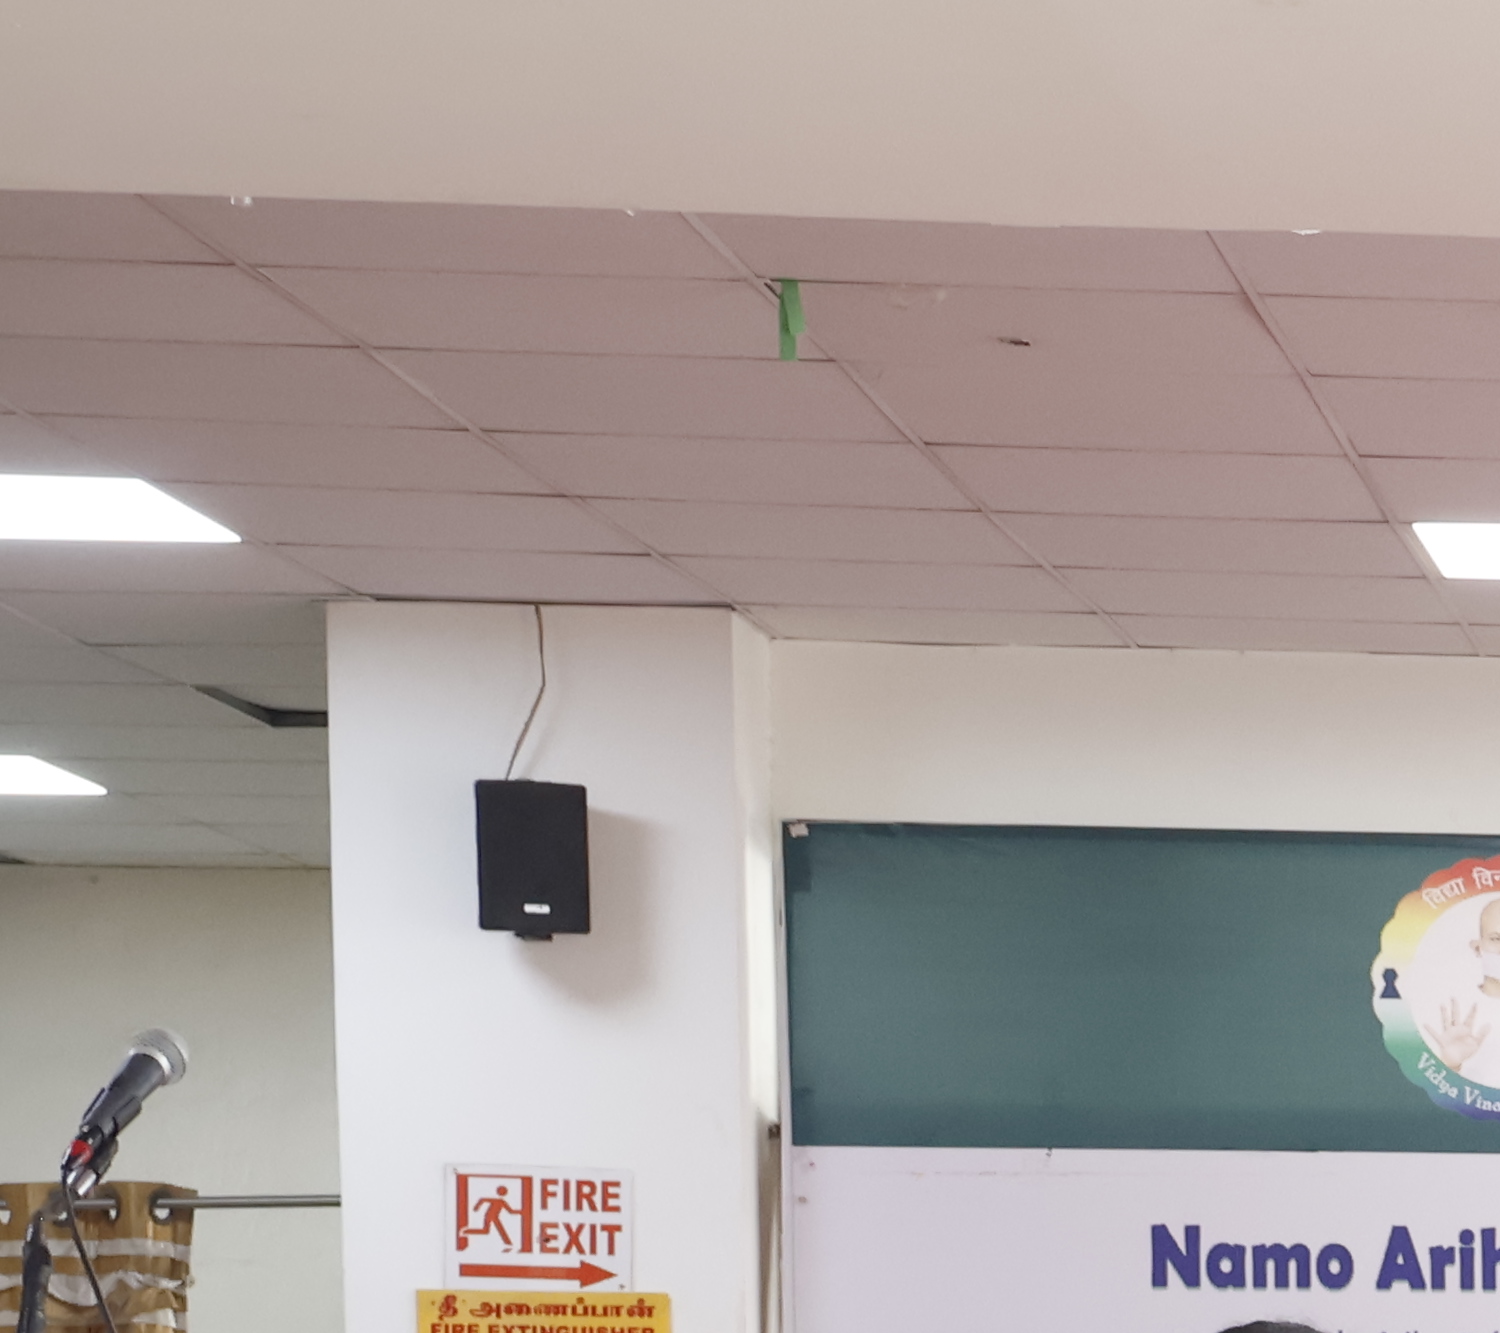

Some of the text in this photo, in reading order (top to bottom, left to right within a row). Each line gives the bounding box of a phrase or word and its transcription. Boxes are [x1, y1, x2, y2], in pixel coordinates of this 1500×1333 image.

[1416, 1052, 1458, 1099] Vidya
[540, 1180, 622, 1212] FIRE
[539, 1224, 623, 1255] EXIT
[1150, 1225, 1352, 1292] Namo
[438, 1294, 459, 1320] தீ
